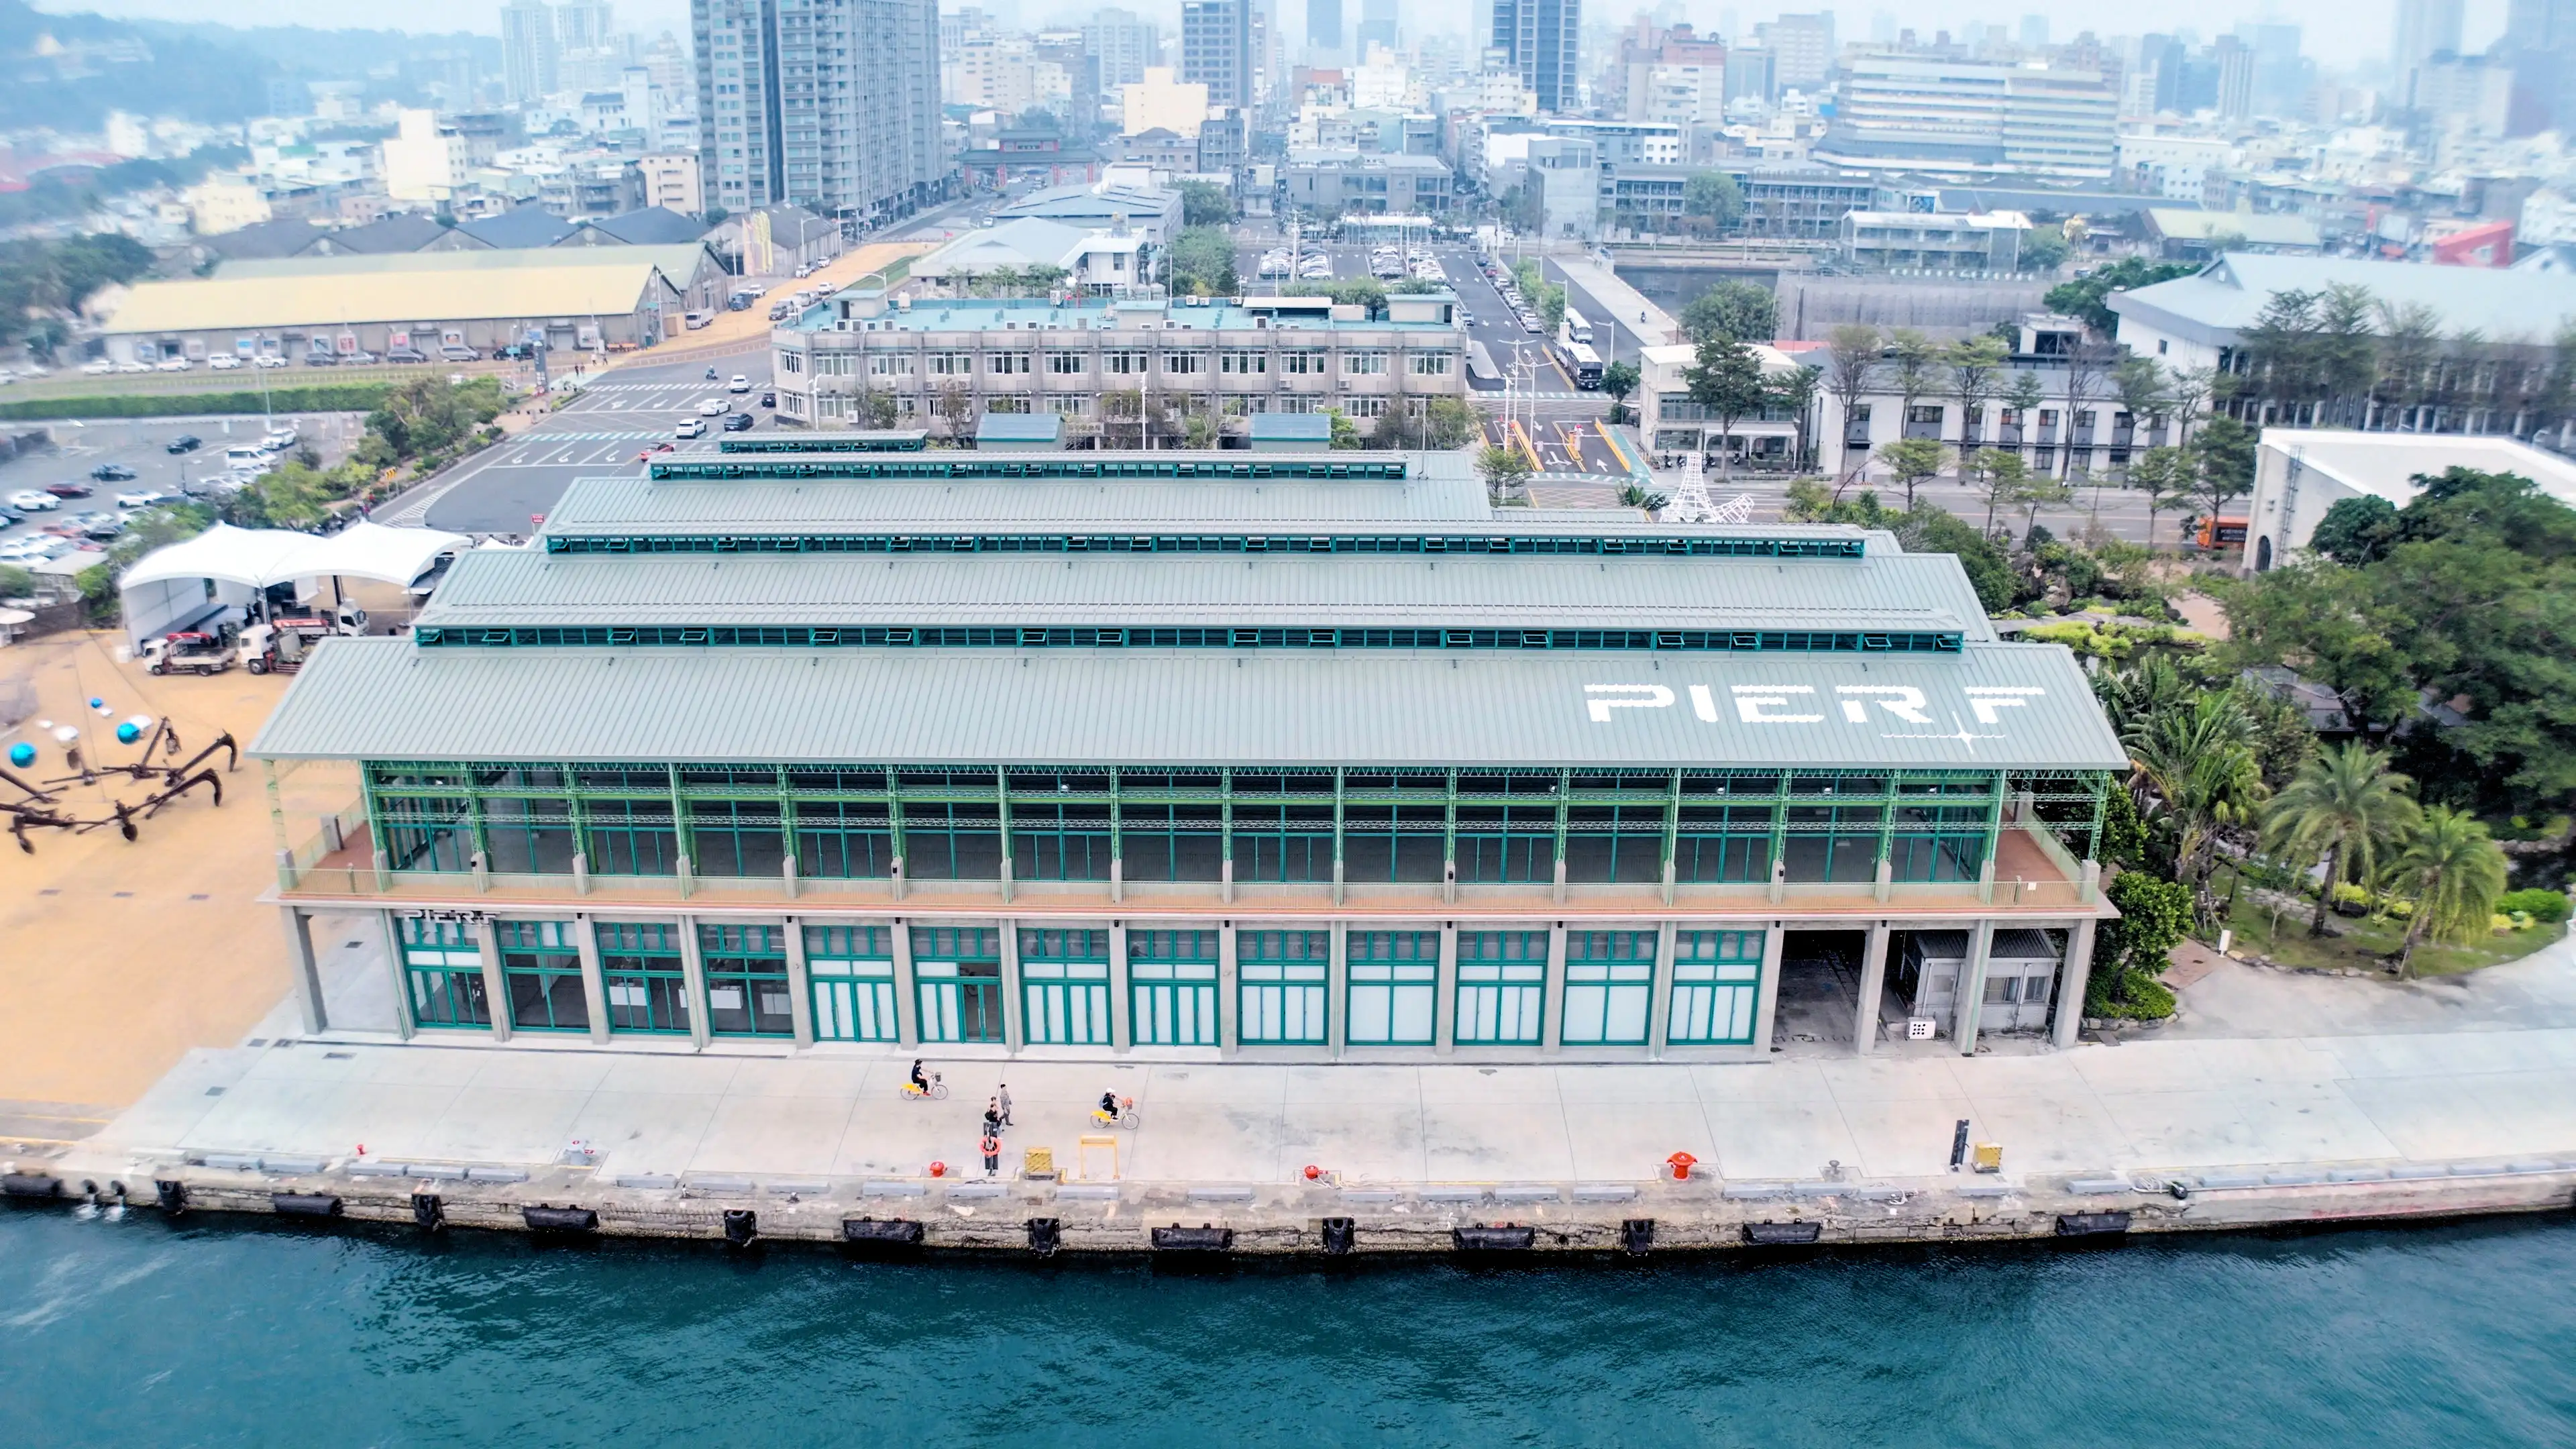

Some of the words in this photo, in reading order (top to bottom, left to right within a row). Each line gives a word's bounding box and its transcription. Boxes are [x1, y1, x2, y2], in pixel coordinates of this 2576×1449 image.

[1584, 684, 1935, 723] PIER
[1964, 686, 2046, 724] F
[403, 910, 475, 924] PIER
[482, 911, 501, 924] F
